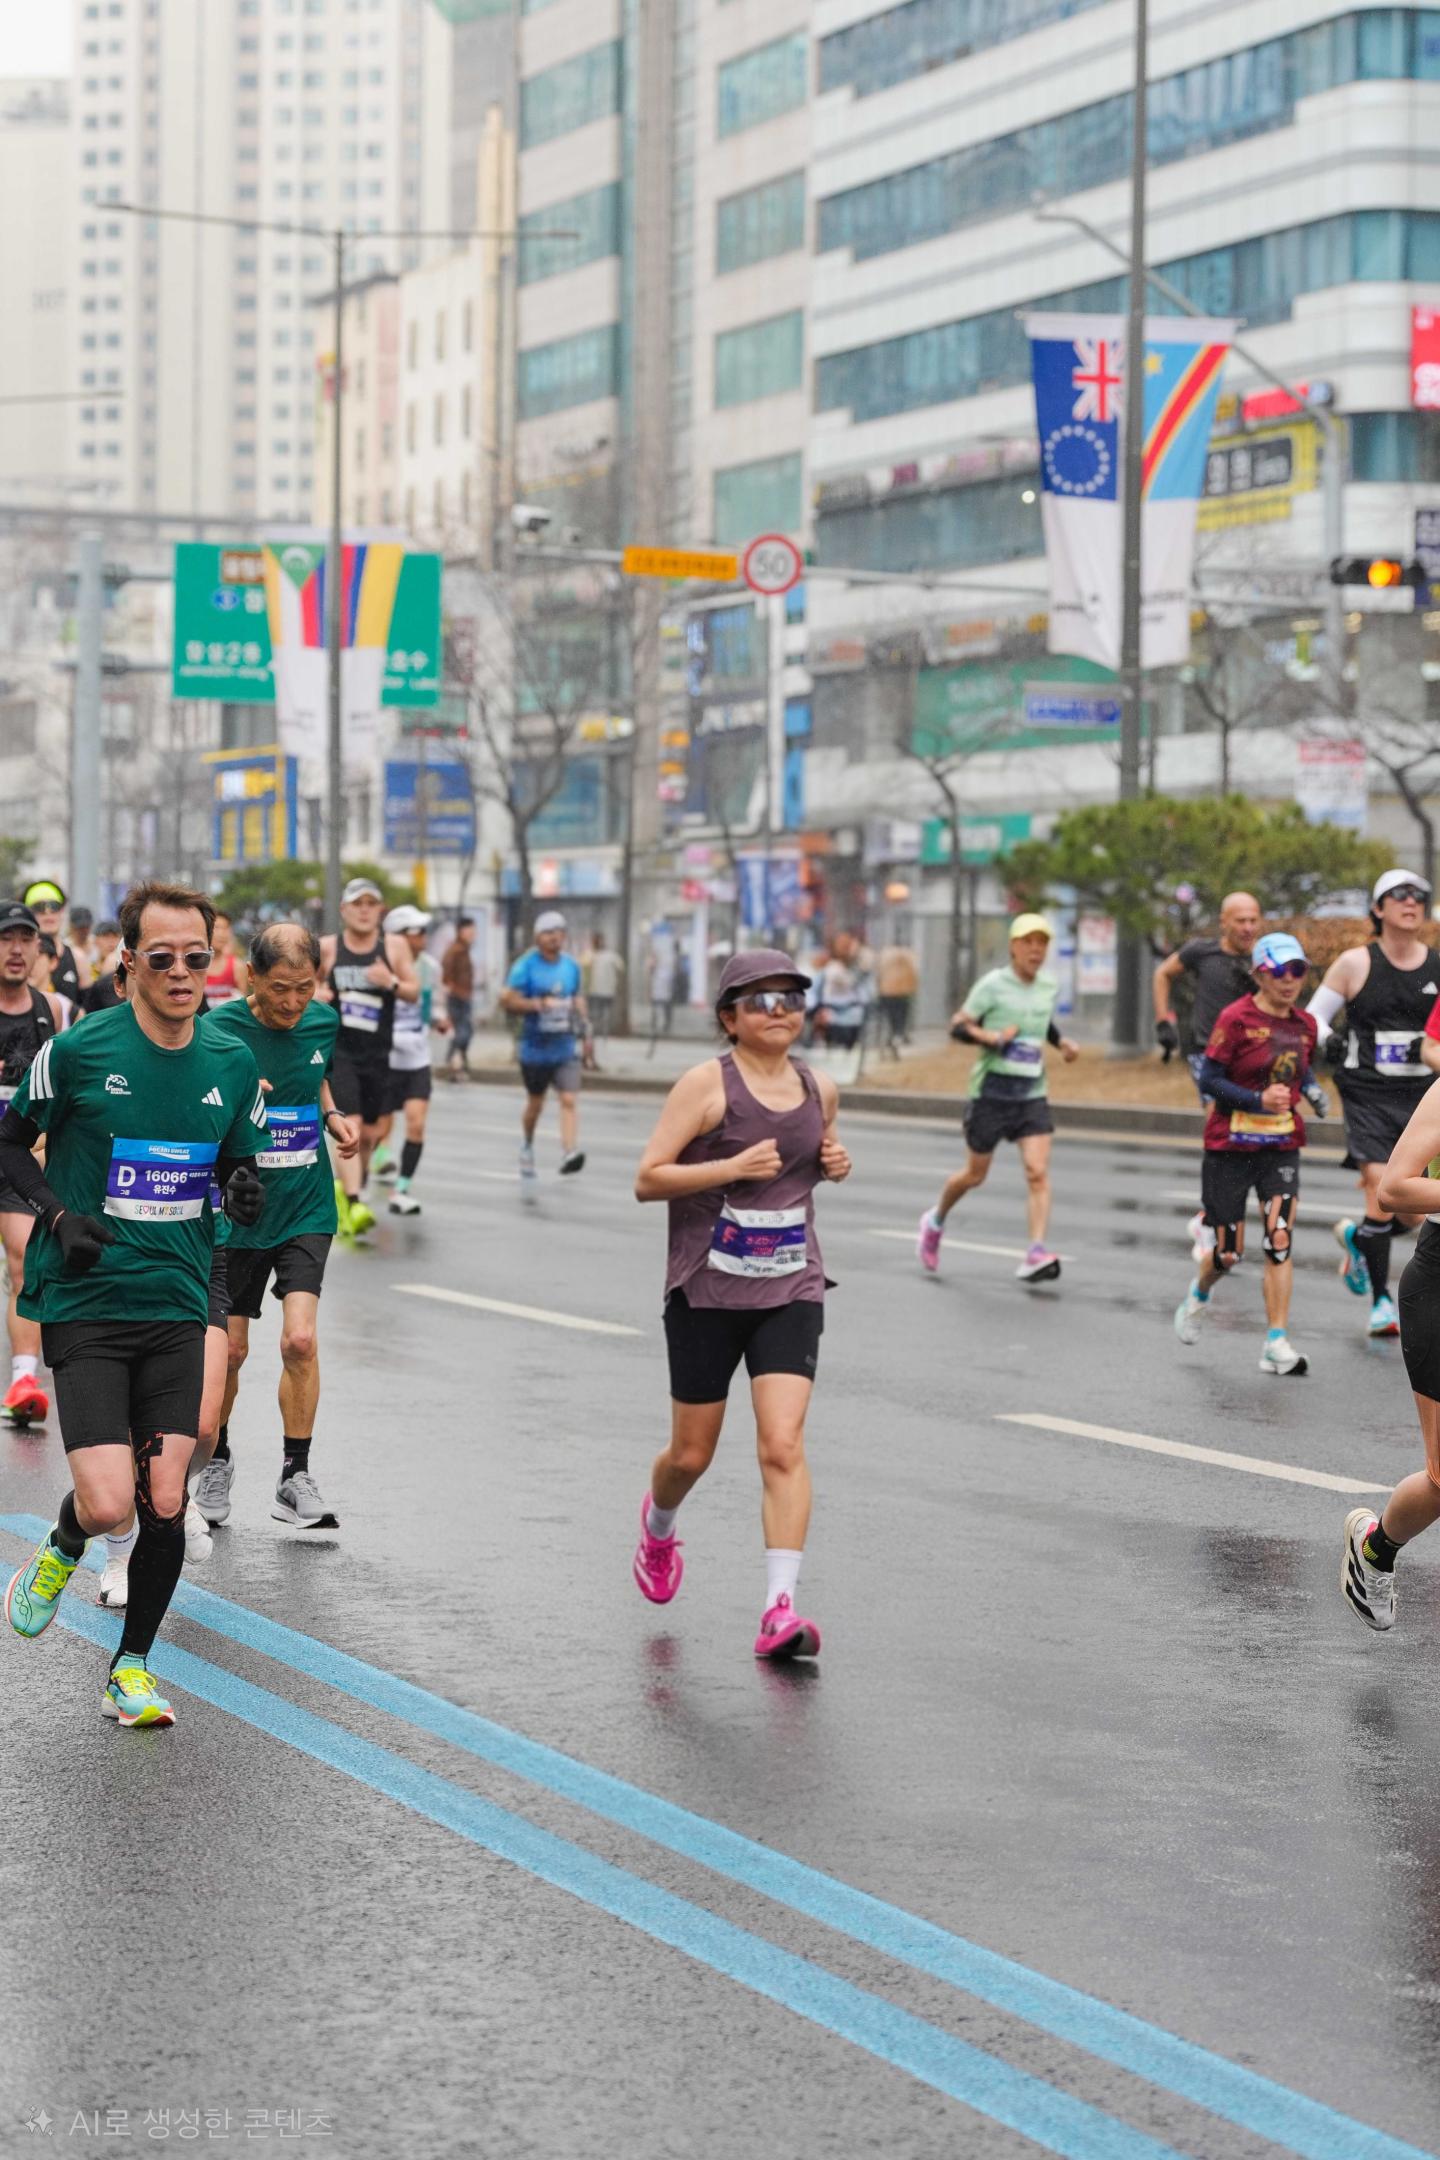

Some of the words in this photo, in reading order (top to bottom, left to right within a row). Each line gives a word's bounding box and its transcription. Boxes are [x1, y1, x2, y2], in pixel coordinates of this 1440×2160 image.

[757, 550, 790, 579] 50
[117, 1165, 136, 1187] D
[145, 1169, 188, 1184] 16066
